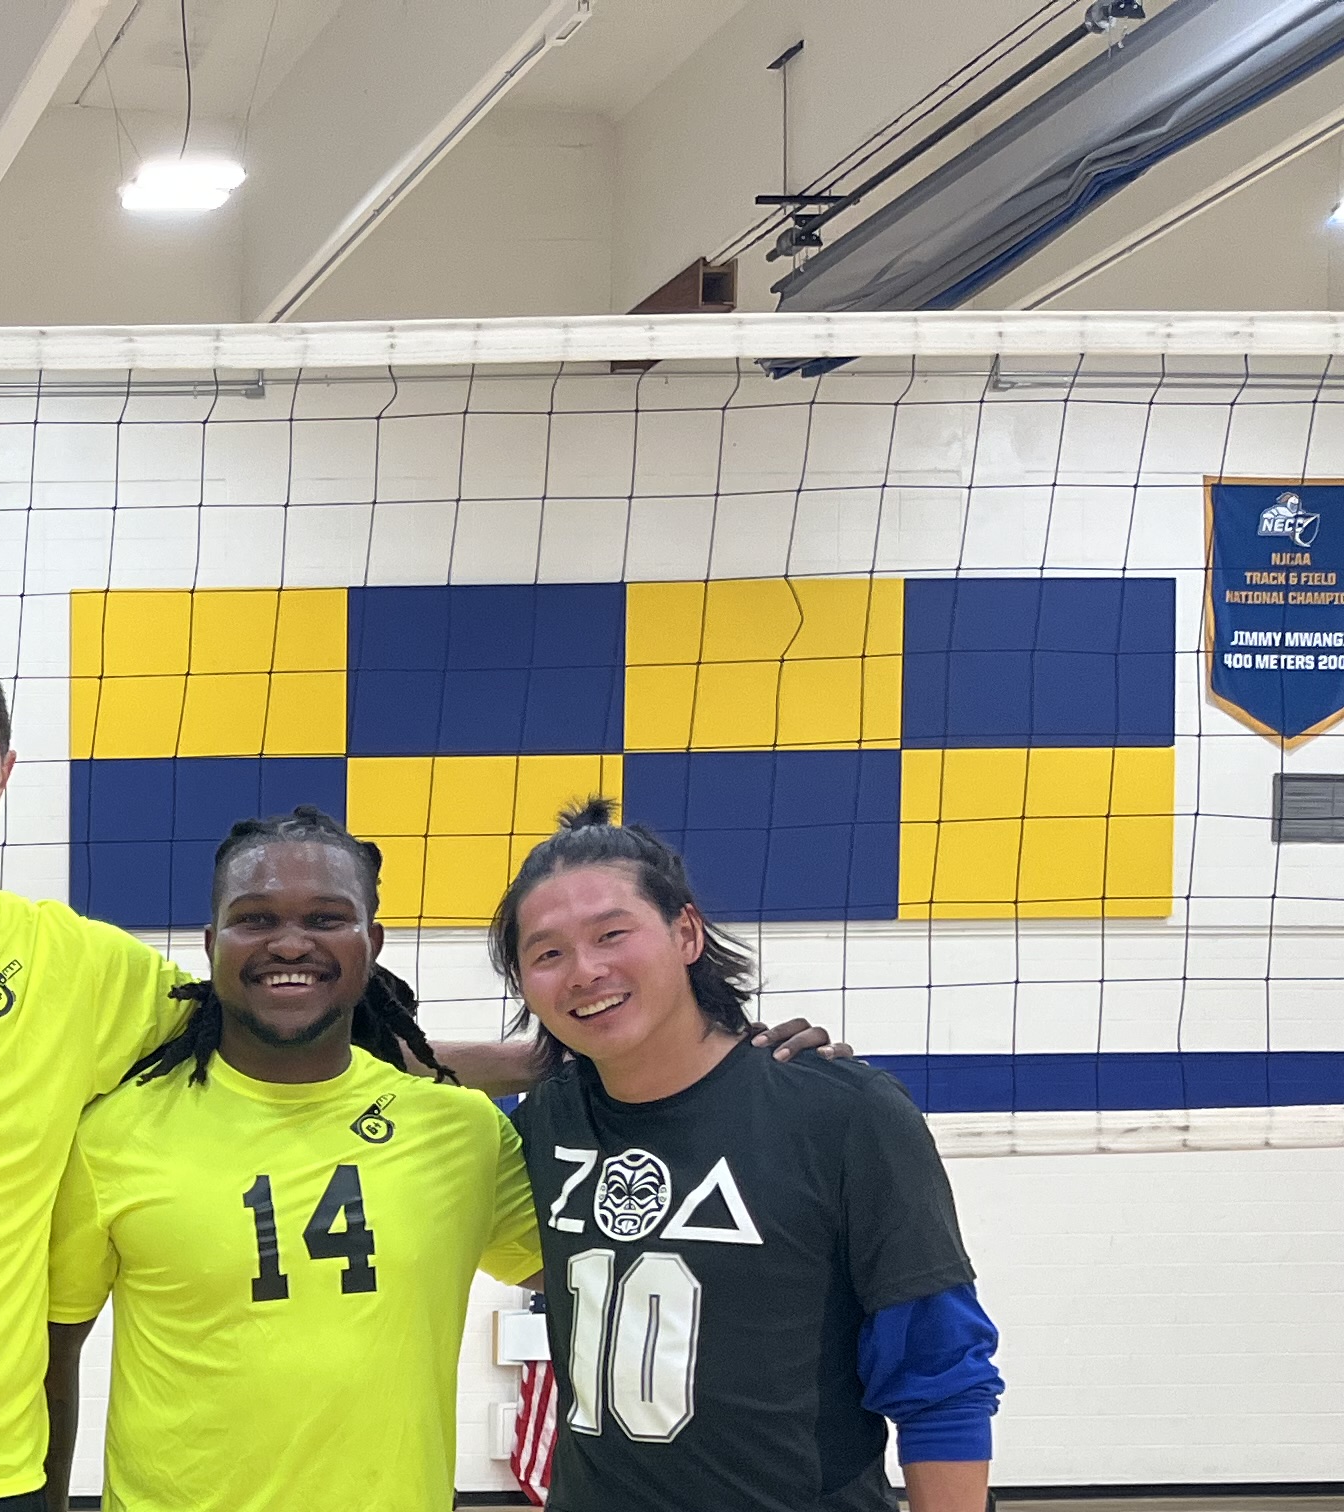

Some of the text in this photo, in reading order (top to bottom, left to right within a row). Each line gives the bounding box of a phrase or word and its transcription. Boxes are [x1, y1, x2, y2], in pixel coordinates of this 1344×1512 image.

[1271, 552, 1311, 566] NJCAA
[1244, 571, 1286, 585] TRACK
[1301, 572, 1336, 585] FIELD
[1226, 590, 1284, 604] NATIONAL
[1230, 630, 1344, 647] JIMMY MWANG
[1224, 653, 1252, 669] 400
[1255, 654, 1314, 670] METERS
[242, 1164, 378, 1302] 14
[567, 1248, 702, 1443] 10
